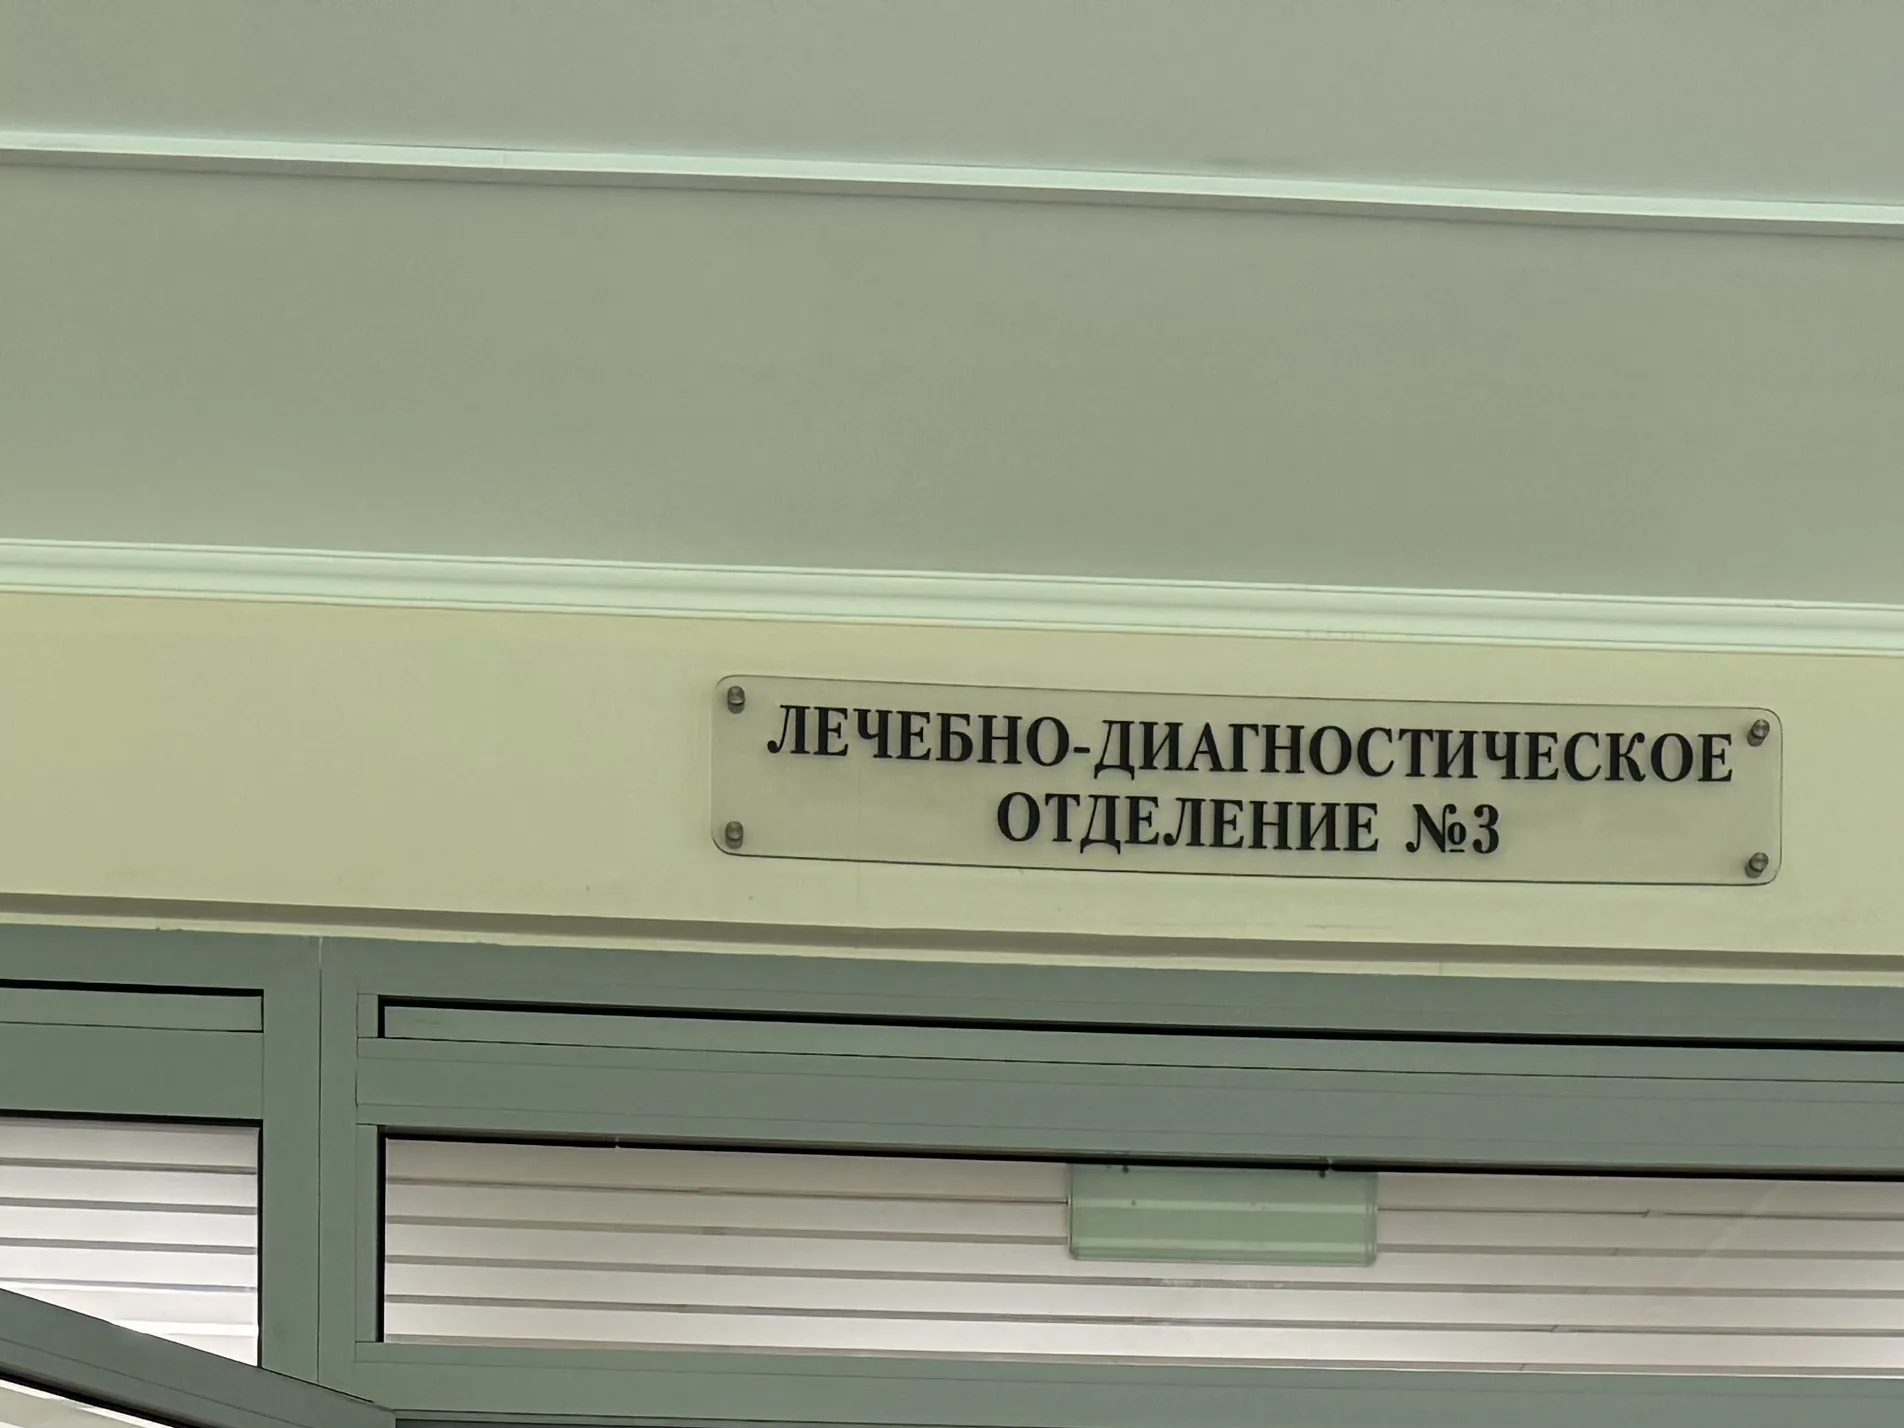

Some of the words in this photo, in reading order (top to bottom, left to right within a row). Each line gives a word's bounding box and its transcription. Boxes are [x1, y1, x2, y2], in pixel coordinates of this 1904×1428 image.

[766, 704, 1736, 784] ЛЕЧЕБНО-ДИАГНОСТИЧЕСКОЕ
[996, 790, 1379, 854] ОТДЕЛЕНИЕ
[1405, 803, 1501, 854] №3
